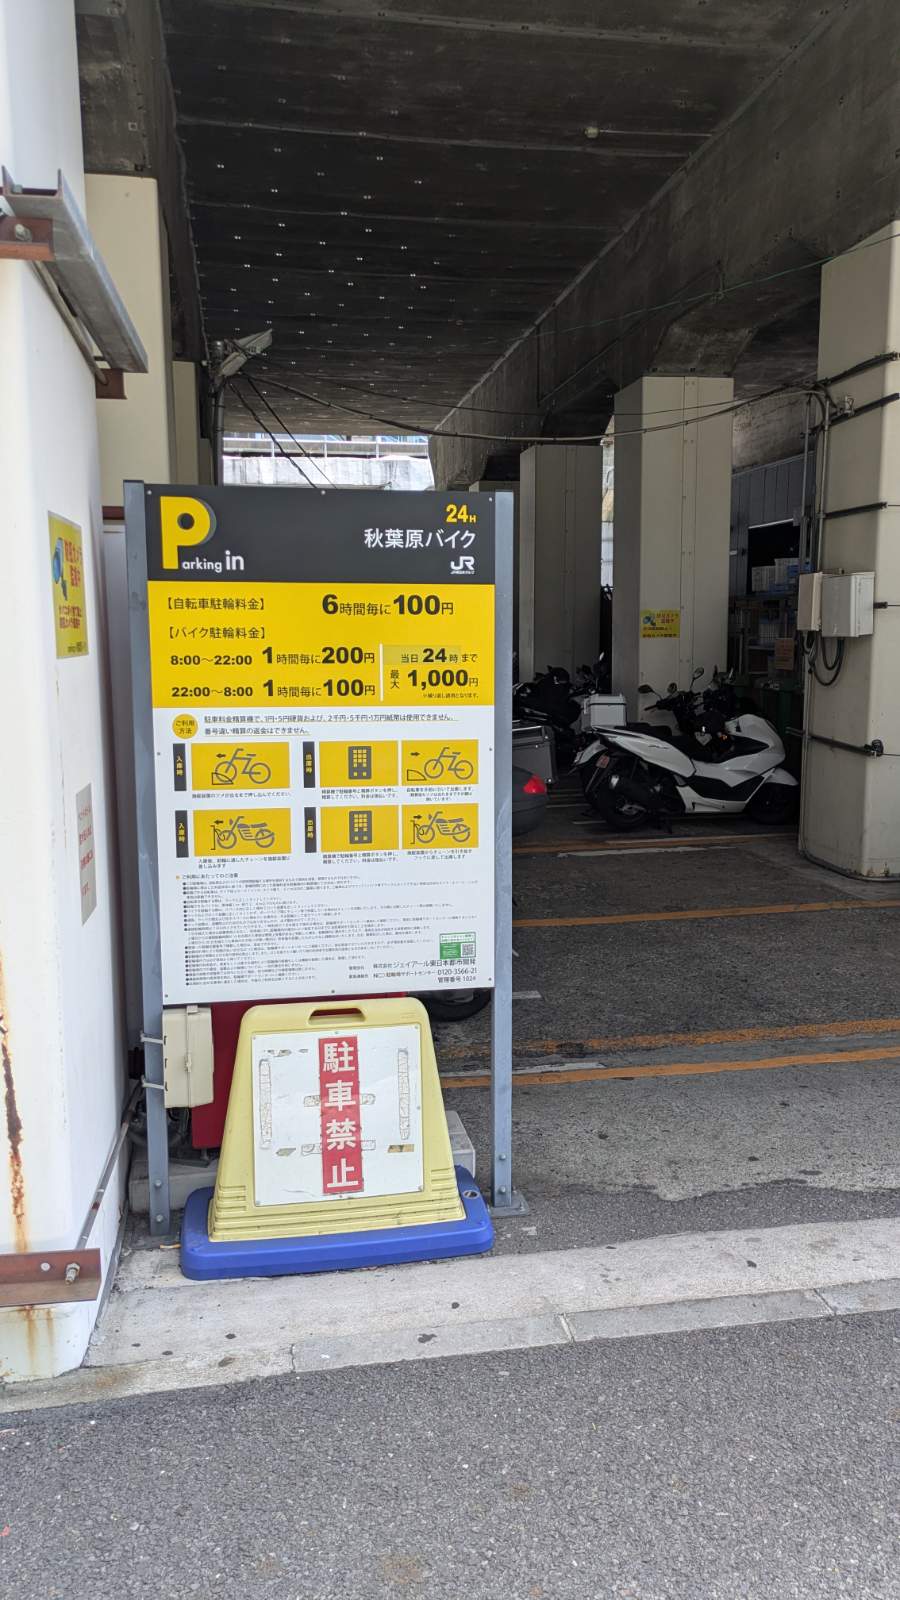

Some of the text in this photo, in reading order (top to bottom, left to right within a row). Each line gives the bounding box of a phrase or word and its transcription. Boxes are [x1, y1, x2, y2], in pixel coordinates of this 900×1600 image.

[364, 528, 476, 549] 秋葉原バイク
[225, 550, 244, 570] in
[450, 556, 475, 570] JR
[167, 597, 265, 610] 【自転車駐輪料金】
[169, 626, 266, 639] 【バイク駐輪料金】
[390, 669, 479, 690] 最大 1,000円
[175, 719, 195, 727] ご利用
[323, 1041, 359, 1189] 駐車禁止
